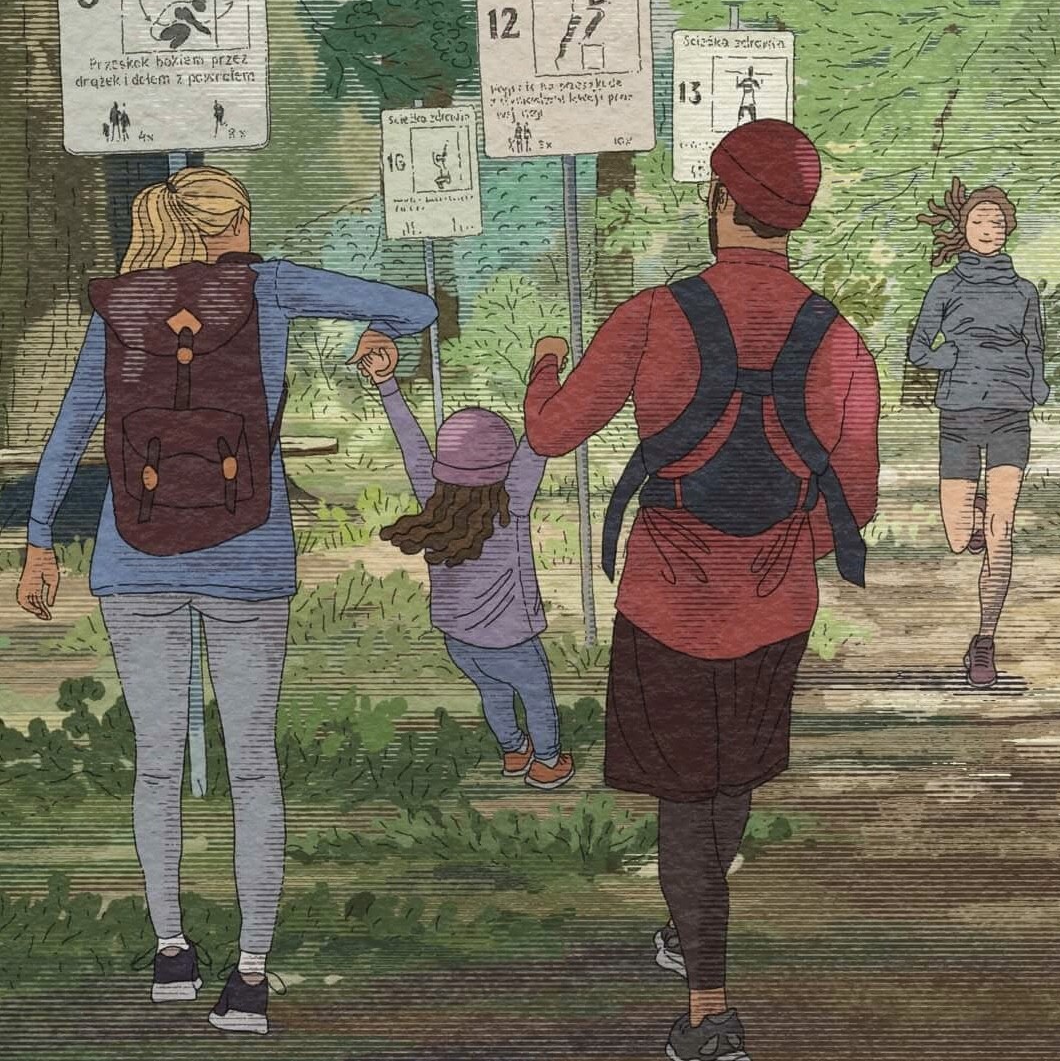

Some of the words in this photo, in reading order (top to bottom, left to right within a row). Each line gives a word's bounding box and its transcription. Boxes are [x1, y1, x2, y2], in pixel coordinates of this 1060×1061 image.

[487, 6, 521, 40] 12
[89, 56, 150, 70] Przeskok
[156, 54, 204, 67] bokiem
[211, 53, 249, 67] przez
[679, 81, 702, 105] 13
